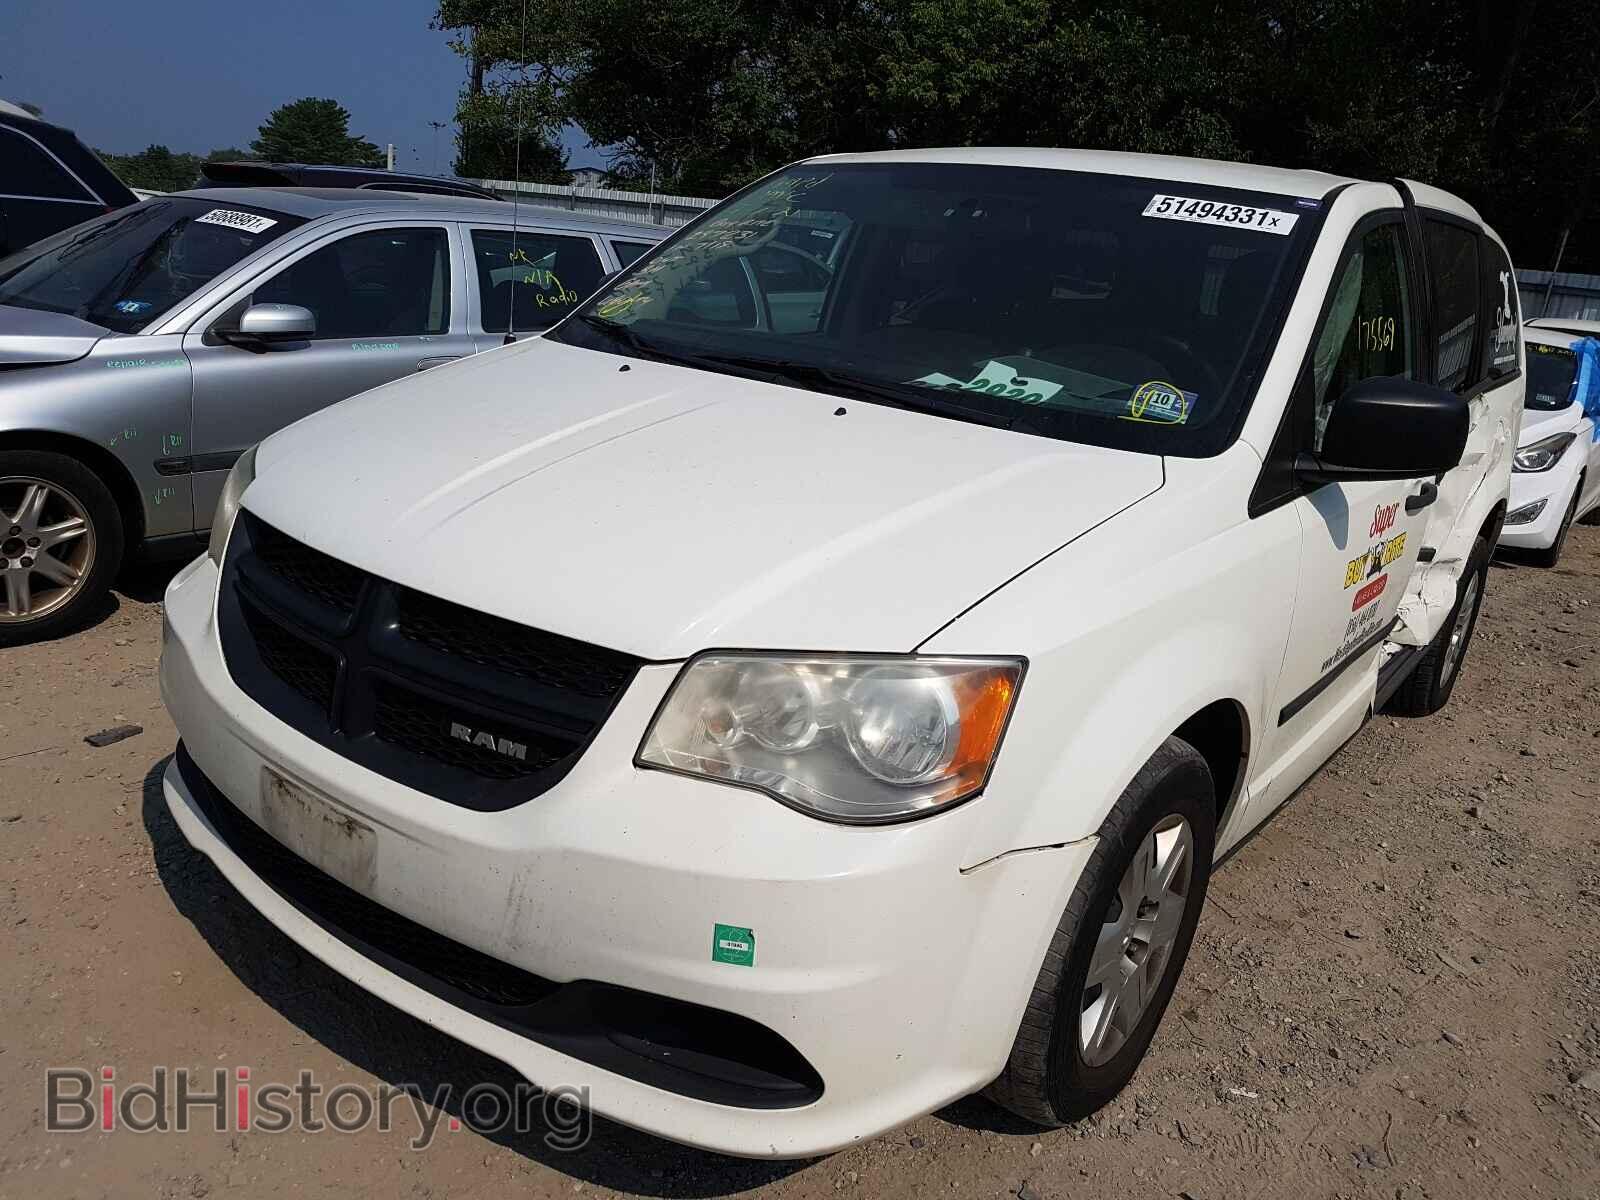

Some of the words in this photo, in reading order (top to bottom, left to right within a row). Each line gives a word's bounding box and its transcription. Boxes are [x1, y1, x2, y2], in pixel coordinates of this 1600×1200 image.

[1153, 392, 1172, 406] 10
[1369, 502, 1400, 538] Super
[450, 722, 527, 761] RAM
